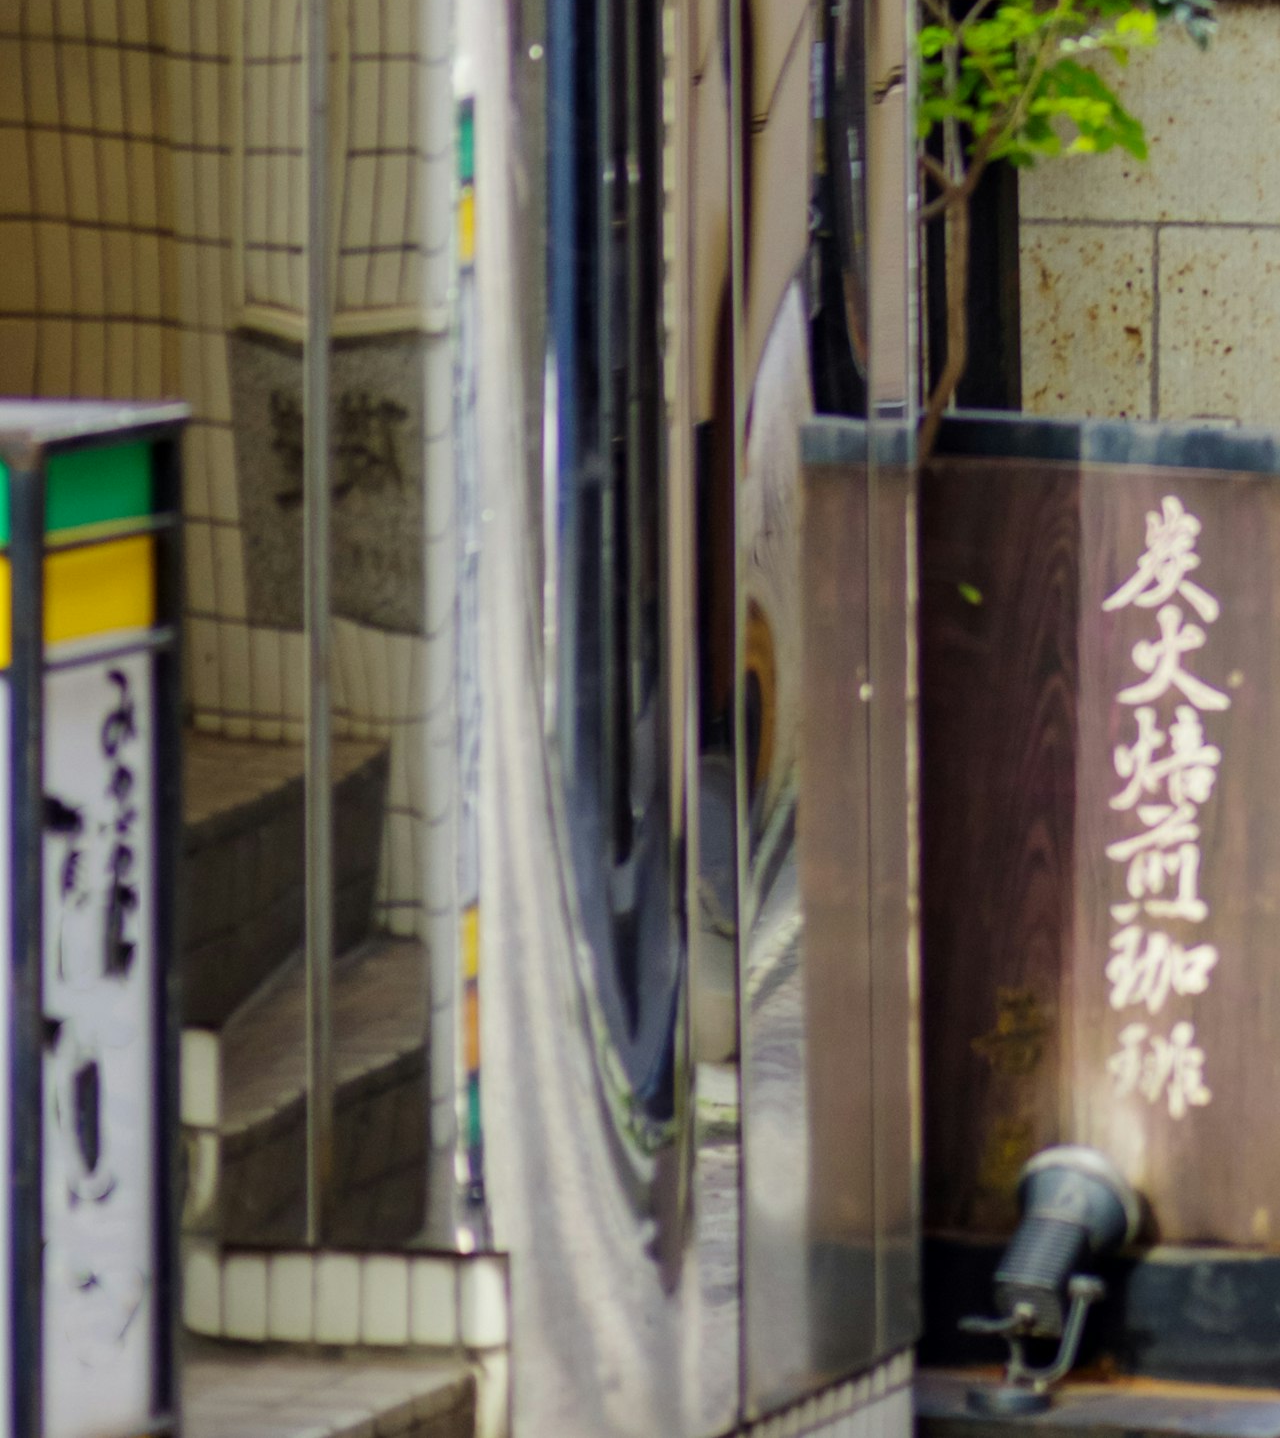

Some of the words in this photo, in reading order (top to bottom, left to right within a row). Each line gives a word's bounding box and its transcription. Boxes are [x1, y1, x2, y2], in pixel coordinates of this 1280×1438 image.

[1100, 495, 1231, 1121] 炭火焙煎珈琲
